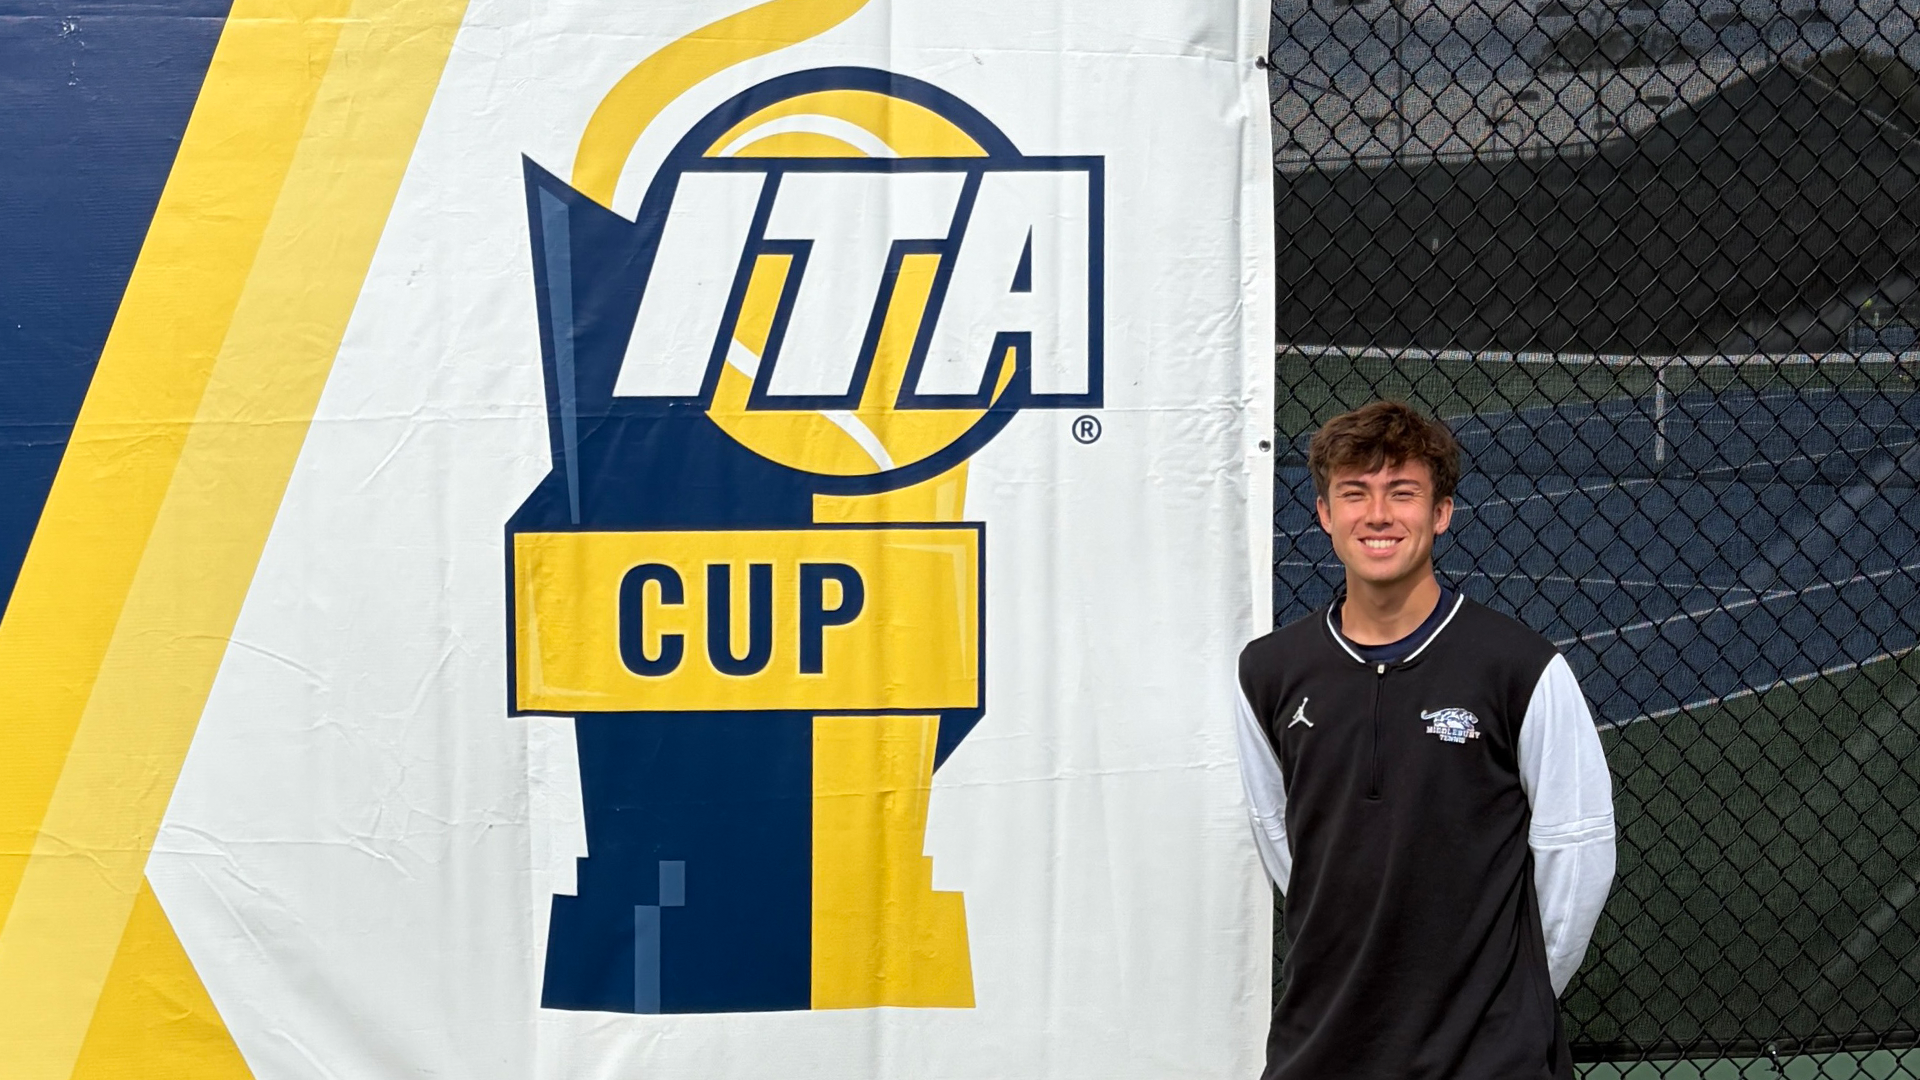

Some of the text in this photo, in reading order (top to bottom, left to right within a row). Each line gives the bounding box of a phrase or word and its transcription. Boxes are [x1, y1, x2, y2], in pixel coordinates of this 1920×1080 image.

[612, 170, 1090, 397] ITA
[618, 562, 866, 677] CUP
[1426, 725, 1481, 739] MIDDLEBURY
[1439, 734, 1466, 744] TENNIS
